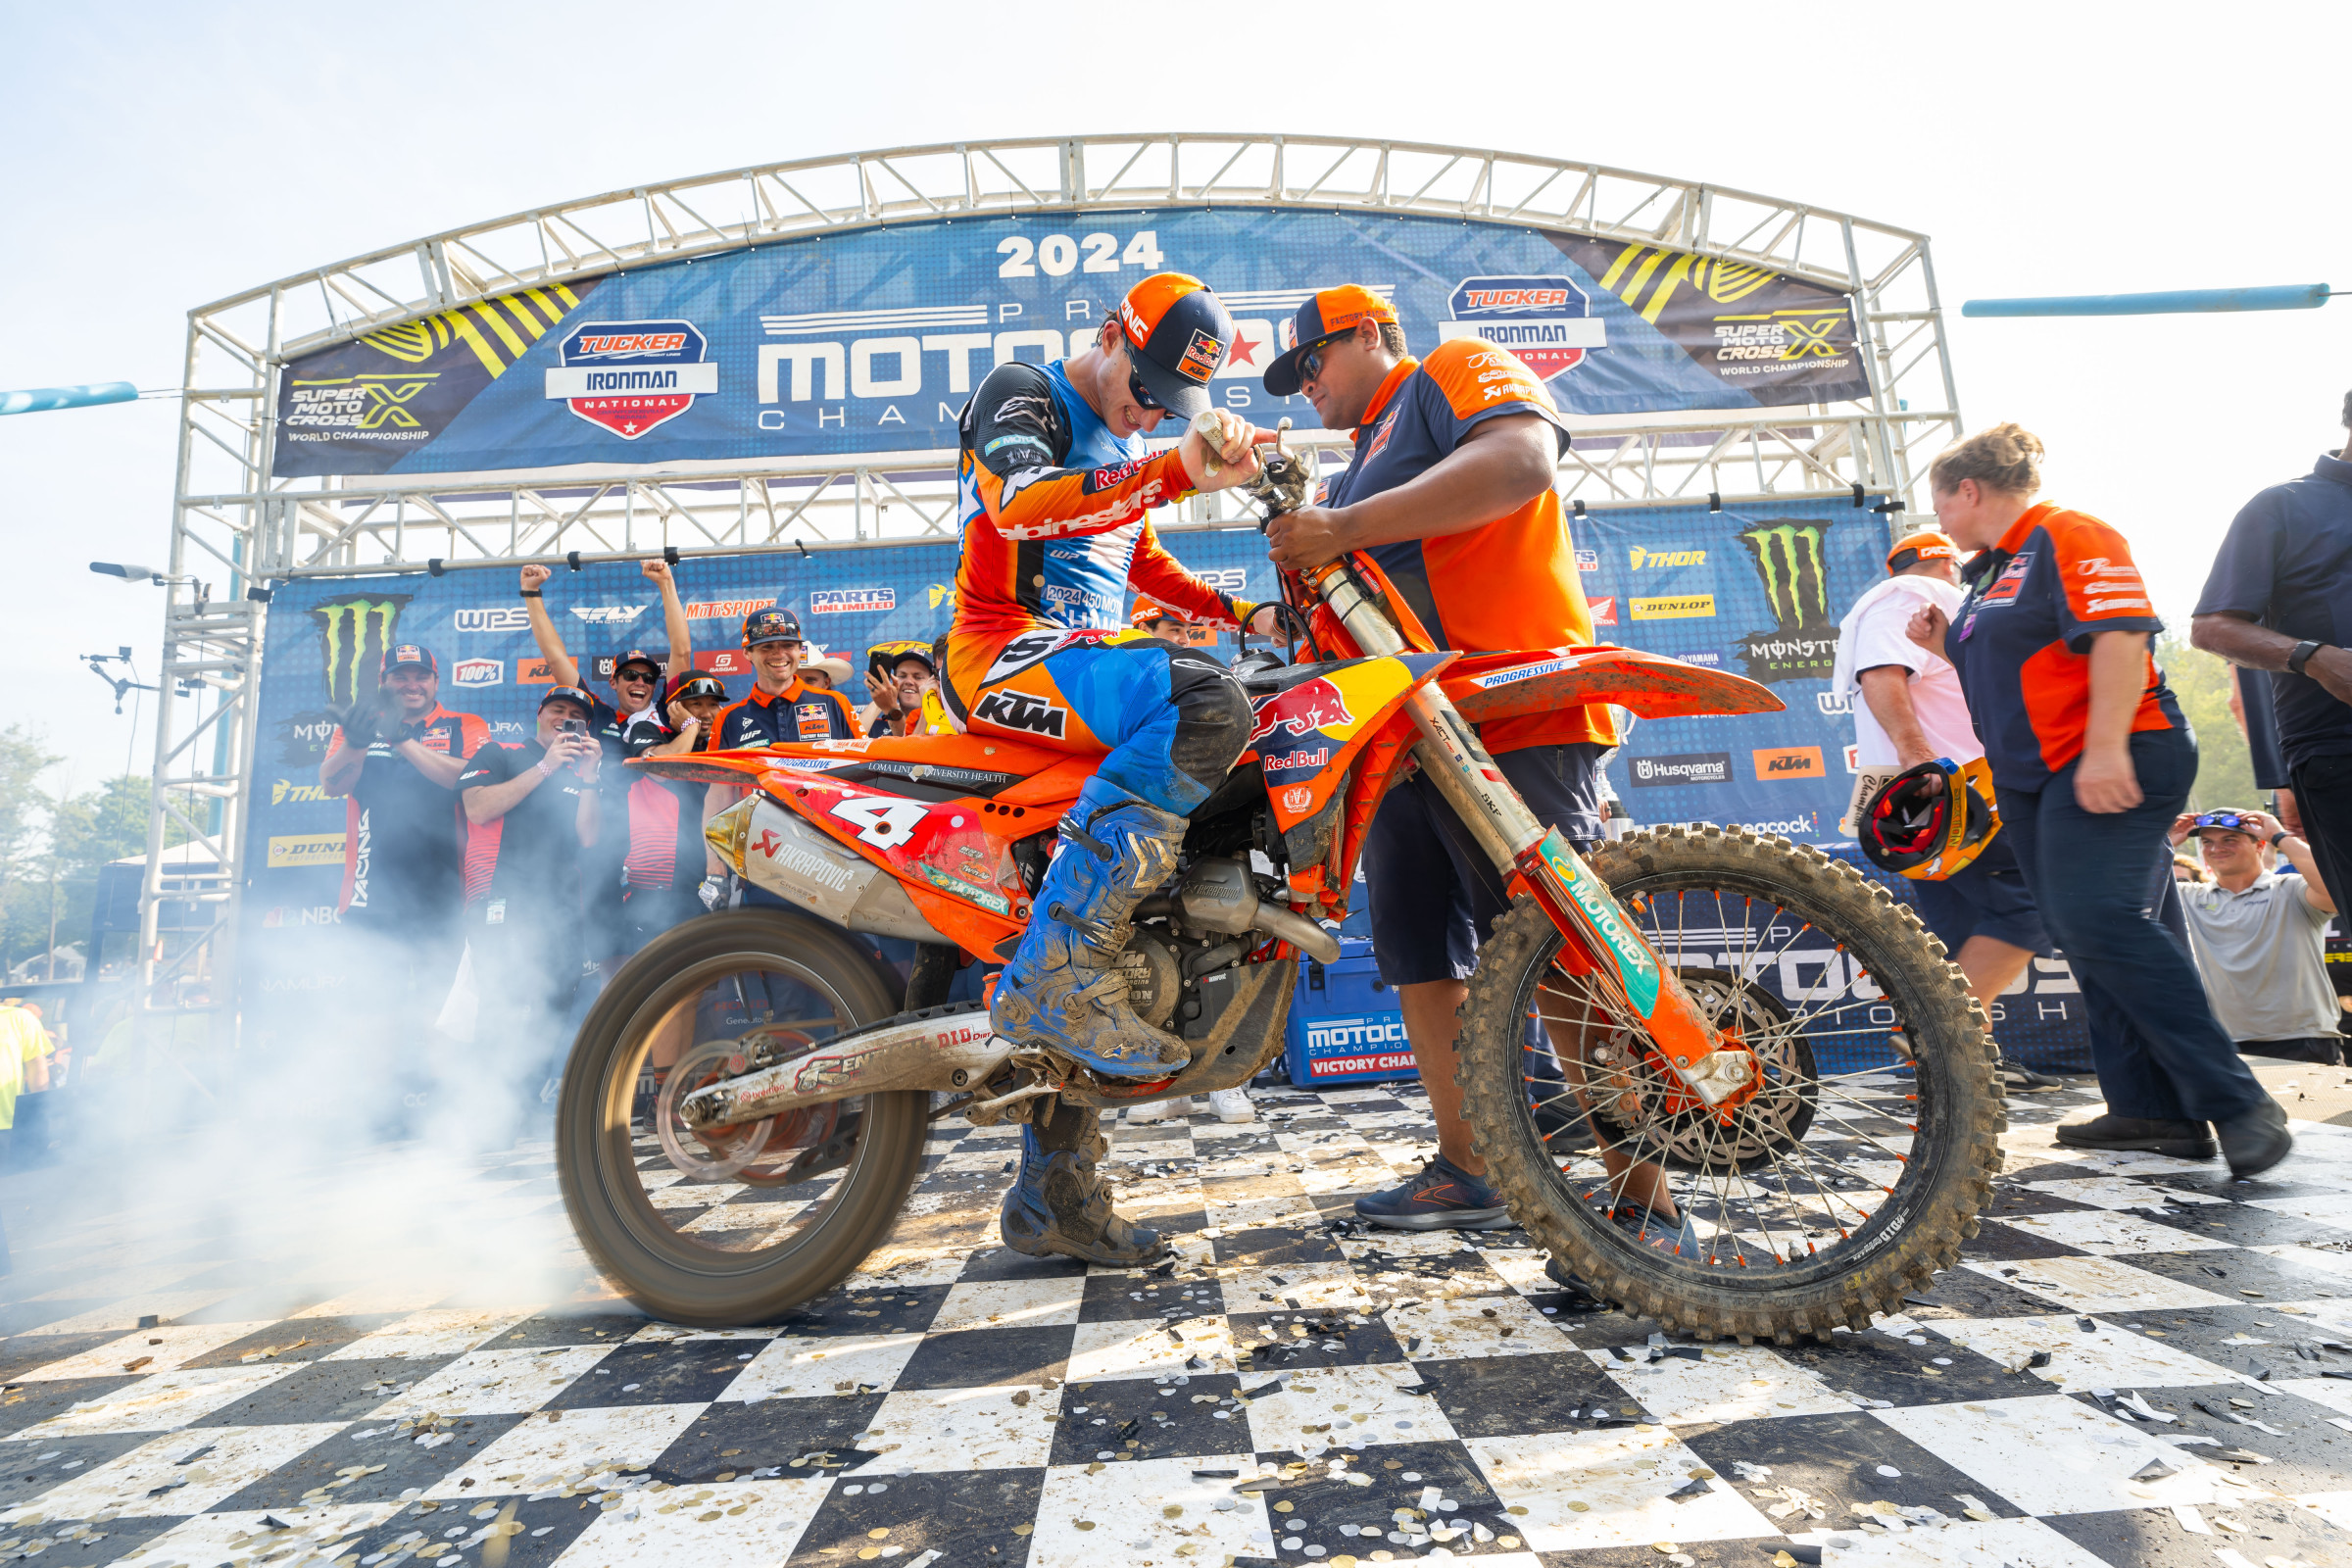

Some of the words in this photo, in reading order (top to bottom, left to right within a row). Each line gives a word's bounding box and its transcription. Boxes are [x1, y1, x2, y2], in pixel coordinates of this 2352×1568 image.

[996, 229, 1164, 279] 2024
[1465, 287, 1569, 308] TUCKER
[999, 299, 1091, 324] PR
[1330, 312, 1364, 326] FACTORY
[1366, 310, 1391, 318] RACING
[1478, 324, 1567, 343] IRONMAN
[1714, 323, 1785, 338] SUPER
[578, 332, 688, 354] TUCKER
[1722, 335, 1785, 347] MOTO
[1516, 351, 1571, 361] IONAL
[1716, 344, 1788, 361] CROSS
[1188, 366, 1206, 378] KTM
[1720, 365, 1761, 376] WORLD
[1762, 359, 1850, 374] CHAMPIONSHIP
[586, 370, 678, 391] IRONMAN
[290, 387, 368, 403] SUPER
[584, 398, 679, 409] NATIONAL
[294, 400, 364, 415] MOTO
[285, 414, 365, 426] CROSS
[288, 432, 330, 442] WORLD
[332, 430, 429, 441] CHAMPIONSHIP
[1645, 550, 1707, 567] THOR
[1197, 569, 1247, 592] PS
[811, 589, 895, 605] PARTS
[1049, 587, 1079, 603] 2024
[1082, 594, 1102, 609] 450
[573, 606, 649, 620] FLY
[812, 601, 895, 613] UNLIMITED
[1643, 600, 1711, 612] DUNLOP
[455, 607, 532, 633] WPS
[1592, 617, 1616, 626] ONDA
[1189, 627, 1207, 641] TM
[1687, 653, 1720, 664] YAMAHA
[1769, 659, 1834, 670] ENERG
[459, 664, 498, 681] 100%
[1484, 661, 1565, 688] PROGRESSIVE
[972, 688, 1068, 740] KTM
[740, 728, 762, 742] WP
[1429, 716, 1450, 742] XACT
[775, 758, 832, 769] PROGRESSIVE
[1264, 752, 1295, 771] Red
[1295, 747, 1330, 768] Bull
[1768, 755, 1812, 771] KTM
[868, 762, 892, 772] LOMA
[893, 764, 911, 774] LIND
[929, 767, 971, 780] IVERSITY
[971, 771, 1006, 784] HEALTH
[1653, 760, 1726, 777] Husqvarna
[1481, 792, 1502, 817] SKF
[829, 797, 931, 851] 4
[1740, 814, 1813, 835] eacock
[290, 842, 346, 855] DUN
[350, 807, 370, 908] RACING
[774, 843, 856, 893] AKRAPOVIČ
[948, 880, 1007, 913] MOTOREX
[1570, 880, 1647, 976] MOTOREX
[1307, 1023, 1409, 1049] MOTOC
[1313, 1058, 1376, 1074] VICTORY
[752, 1084, 785, 1098] brembo
